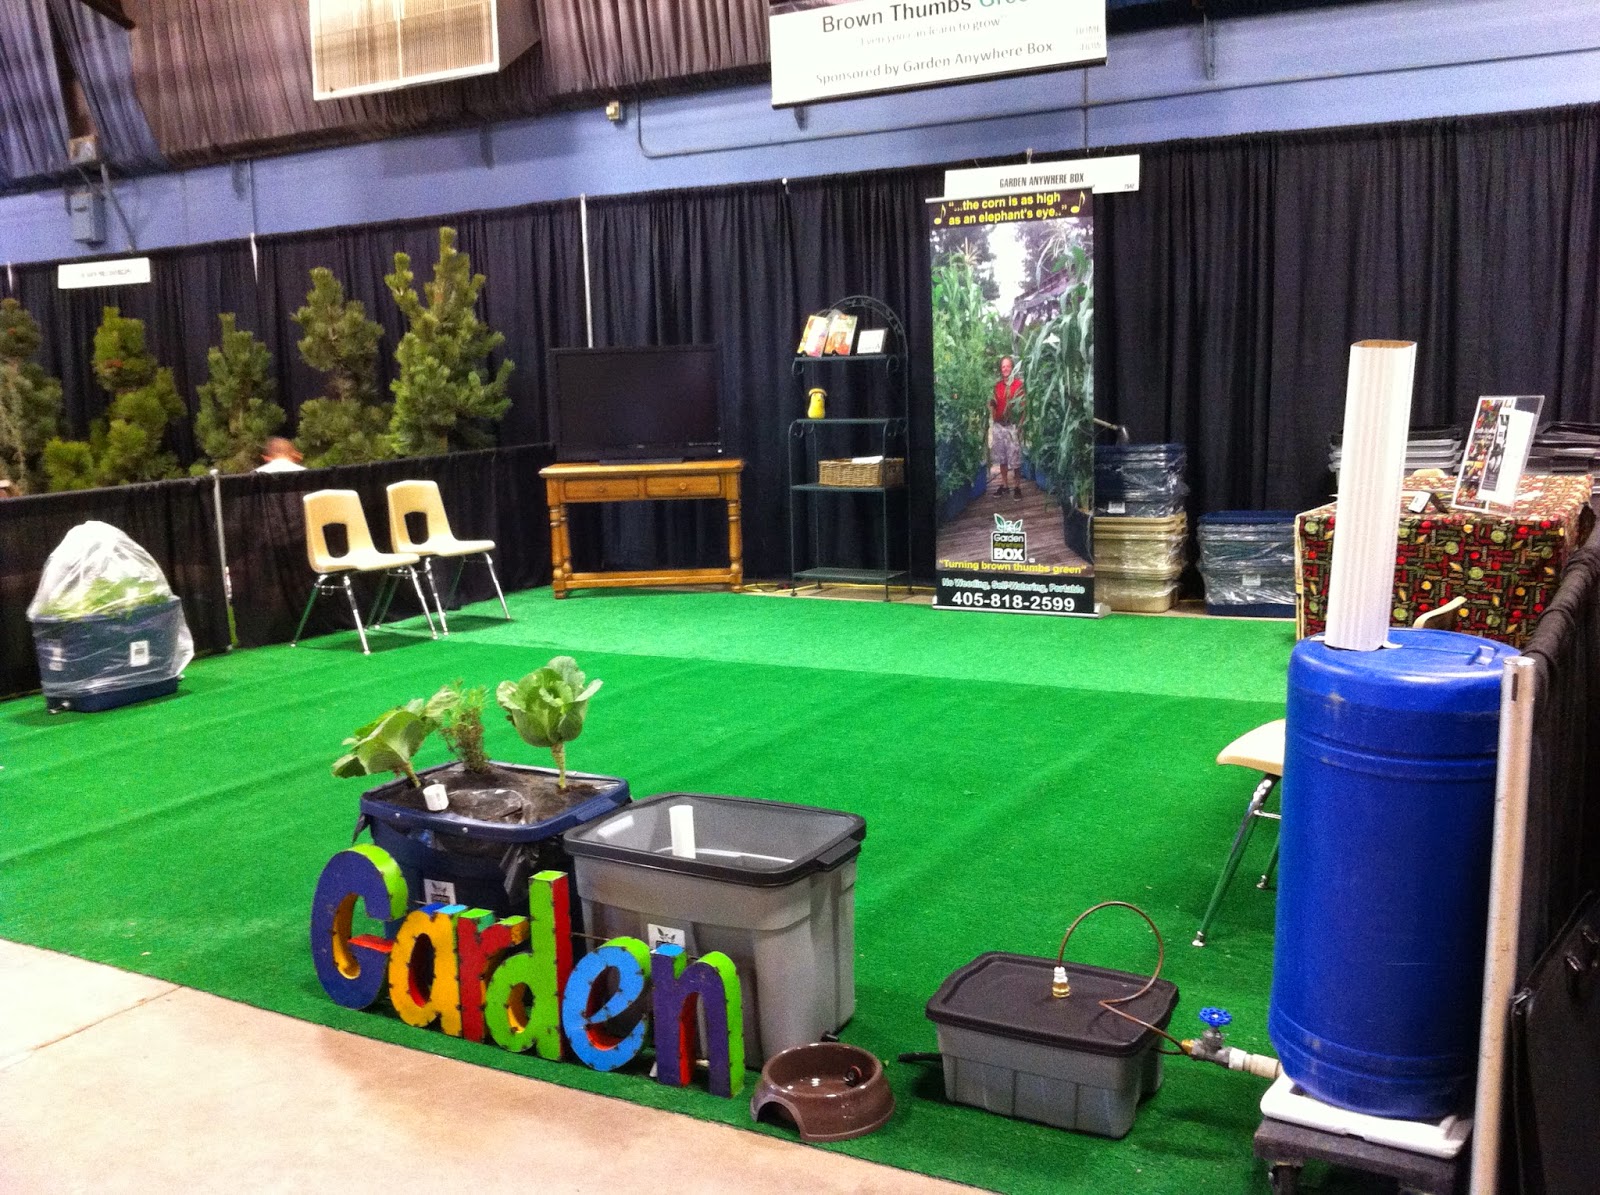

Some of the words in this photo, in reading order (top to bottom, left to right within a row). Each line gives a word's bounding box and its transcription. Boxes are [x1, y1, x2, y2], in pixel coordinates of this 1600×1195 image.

[822, 12, 883, 33] Brown
[890, 0, 973, 22] Thumbs
[959, 21, 970, 31] to
[816, 64, 881, 87] Sponsored
[885, 61, 899, 77] by
[903, 55, 951, 74] Garden
[955, 45, 1023, 67] Anywhere
[1027, 41, 1053, 55] Box
[1000, 177, 1027, 188] GARDEN
[1029, 174, 1067, 187] ANYWHERE
[1069, 173, 1085, 184] BOX
[981, 199, 1006, 210] corn
[1008, 196, 1018, 206] is
[1020, 196, 1034, 206] as
[1036, 191, 1061, 206] high
[948, 215, 961, 225] as
[963, 214, 976, 224] an
[978, 208, 1034, 224] elephant's
[993, 533, 1024, 543] Garden
[993, 548, 1024, 561] BOX
[981, 561, 1011, 571] brown
[1013, 563, 1050, 573] thumbs
[952, 591, 1075, 612] 405-818-2599
[310, 843, 746, 1098] Garden
